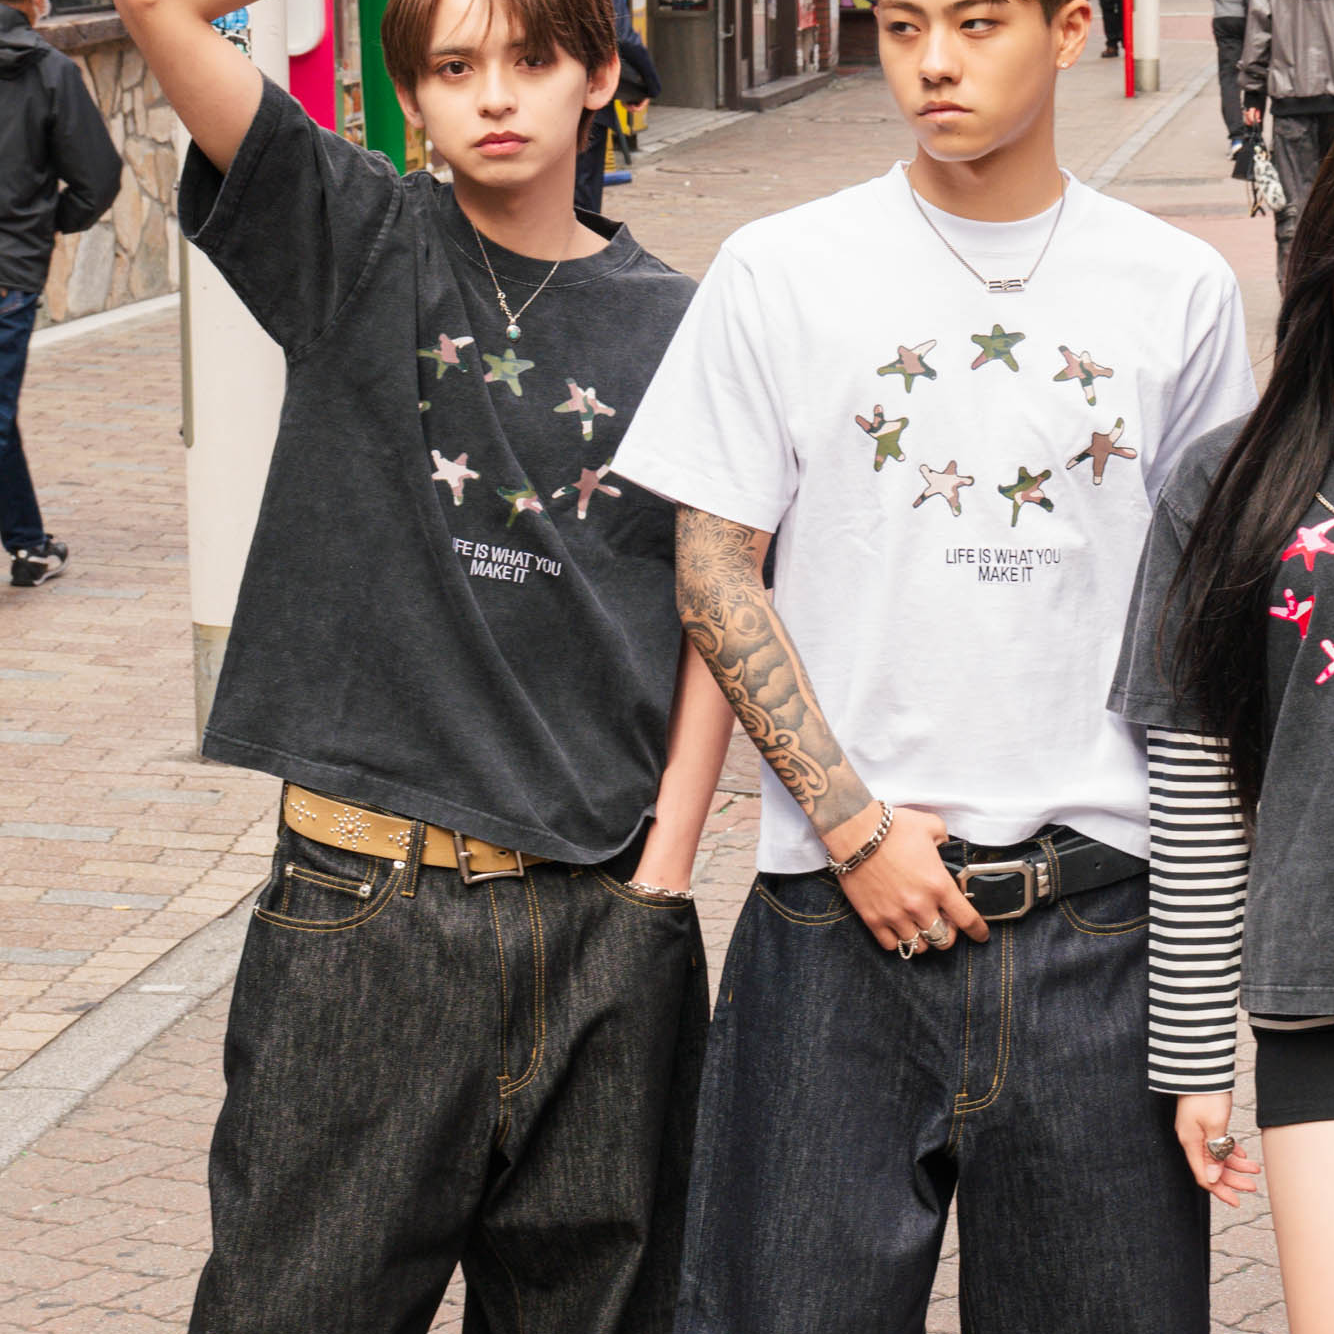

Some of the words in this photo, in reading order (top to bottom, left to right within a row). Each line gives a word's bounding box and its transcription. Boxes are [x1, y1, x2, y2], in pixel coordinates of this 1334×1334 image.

[453, 538, 474, 555] IFE
[475, 543, 489, 559] IS
[492, 546, 533, 567] WHAT
[536, 556, 561, 576] YOU
[946, 548, 975, 564] LIFE
[979, 548, 991, 564] IS
[995, 549, 1033, 565] WHAT
[1037, 549, 1061, 564] YOU
[470, 559, 511, 580] MAKE
[514, 567, 529, 583] IT
[978, 566, 1018, 582] MAKE
[1022, 567, 1033, 582] IT
